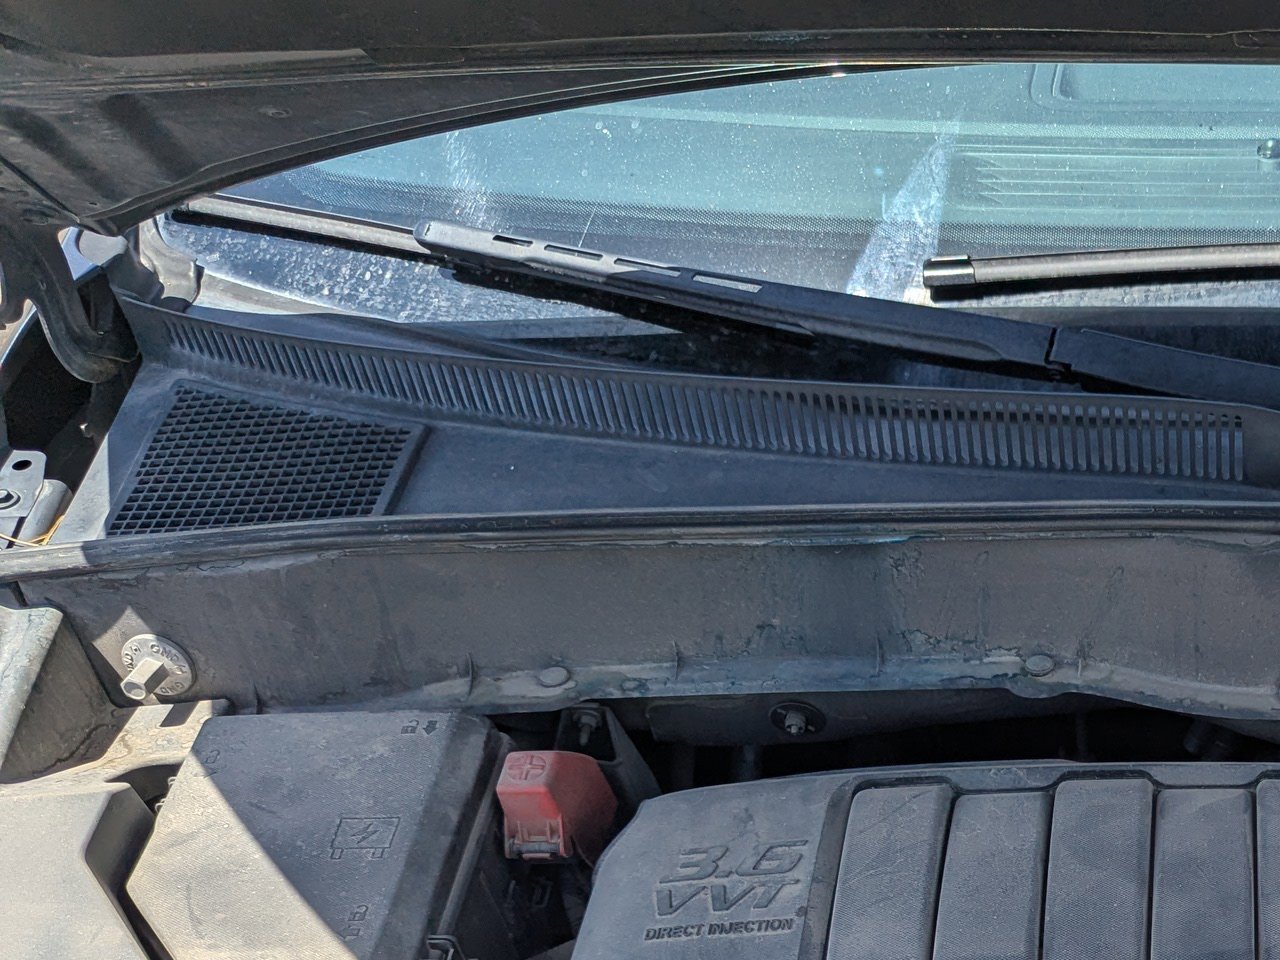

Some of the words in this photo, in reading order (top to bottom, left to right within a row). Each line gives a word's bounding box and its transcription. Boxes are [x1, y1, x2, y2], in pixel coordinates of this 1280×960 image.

[660, 838, 808, 882] 3.6
[654, 878, 800, 917] VVT
[644, 922, 704, 941] DIRECT
[707, 917, 795, 937] INJECTION
